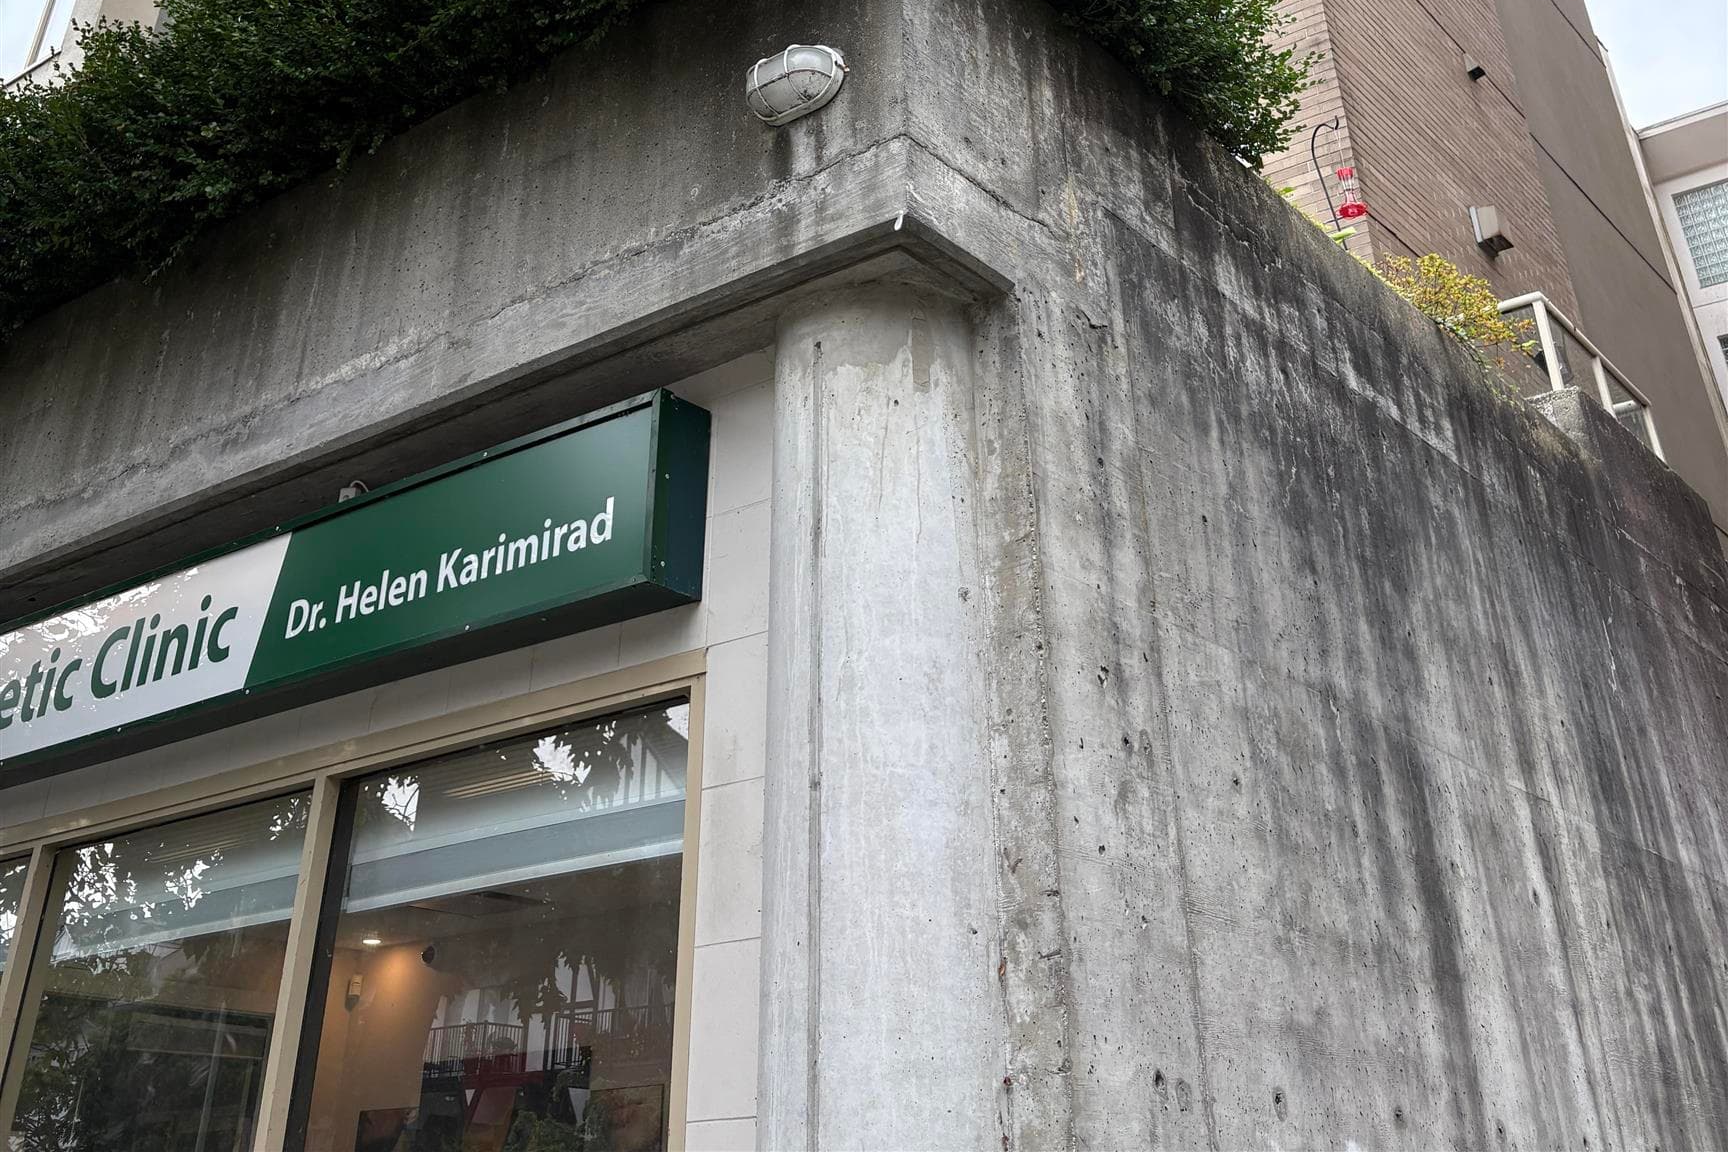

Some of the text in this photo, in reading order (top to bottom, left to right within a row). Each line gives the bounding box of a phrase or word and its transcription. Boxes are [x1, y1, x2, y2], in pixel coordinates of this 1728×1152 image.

[284, 496, 615, 639] Dr. Helen Karimirad
[0, 594, 239, 730] etic Clinic
